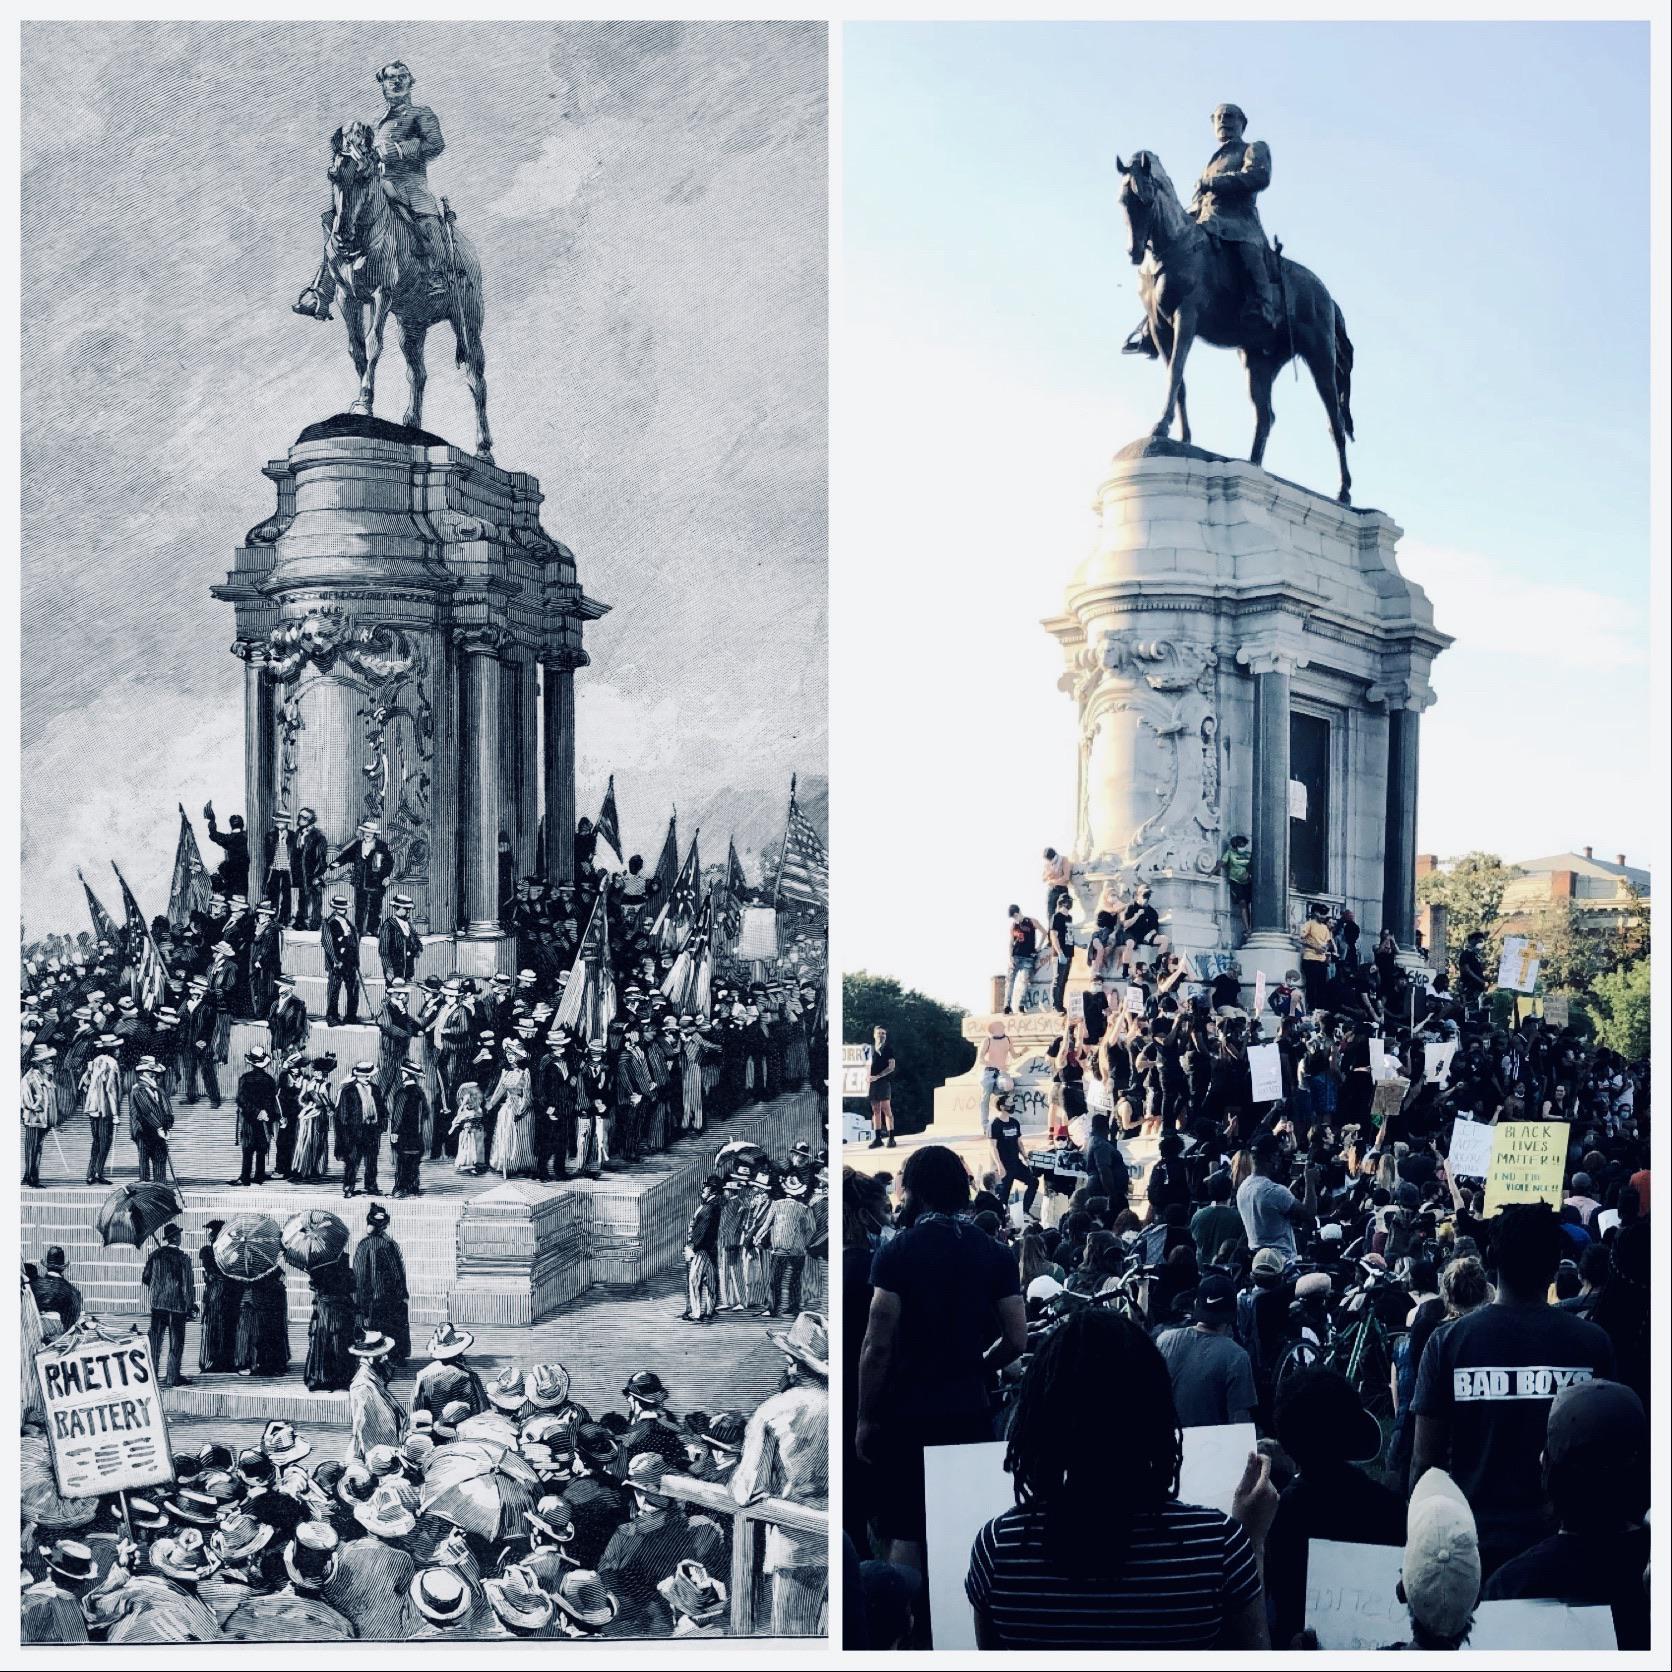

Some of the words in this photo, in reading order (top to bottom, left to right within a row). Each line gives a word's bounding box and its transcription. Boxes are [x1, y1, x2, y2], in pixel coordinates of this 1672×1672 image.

[1504, 1125, 1552, 1138] BLACK
[1512, 1141, 1548, 1152] LIVES
[45, 1349, 149, 1400] RHETTS
[1454, 1371, 1509, 1396] BAD
